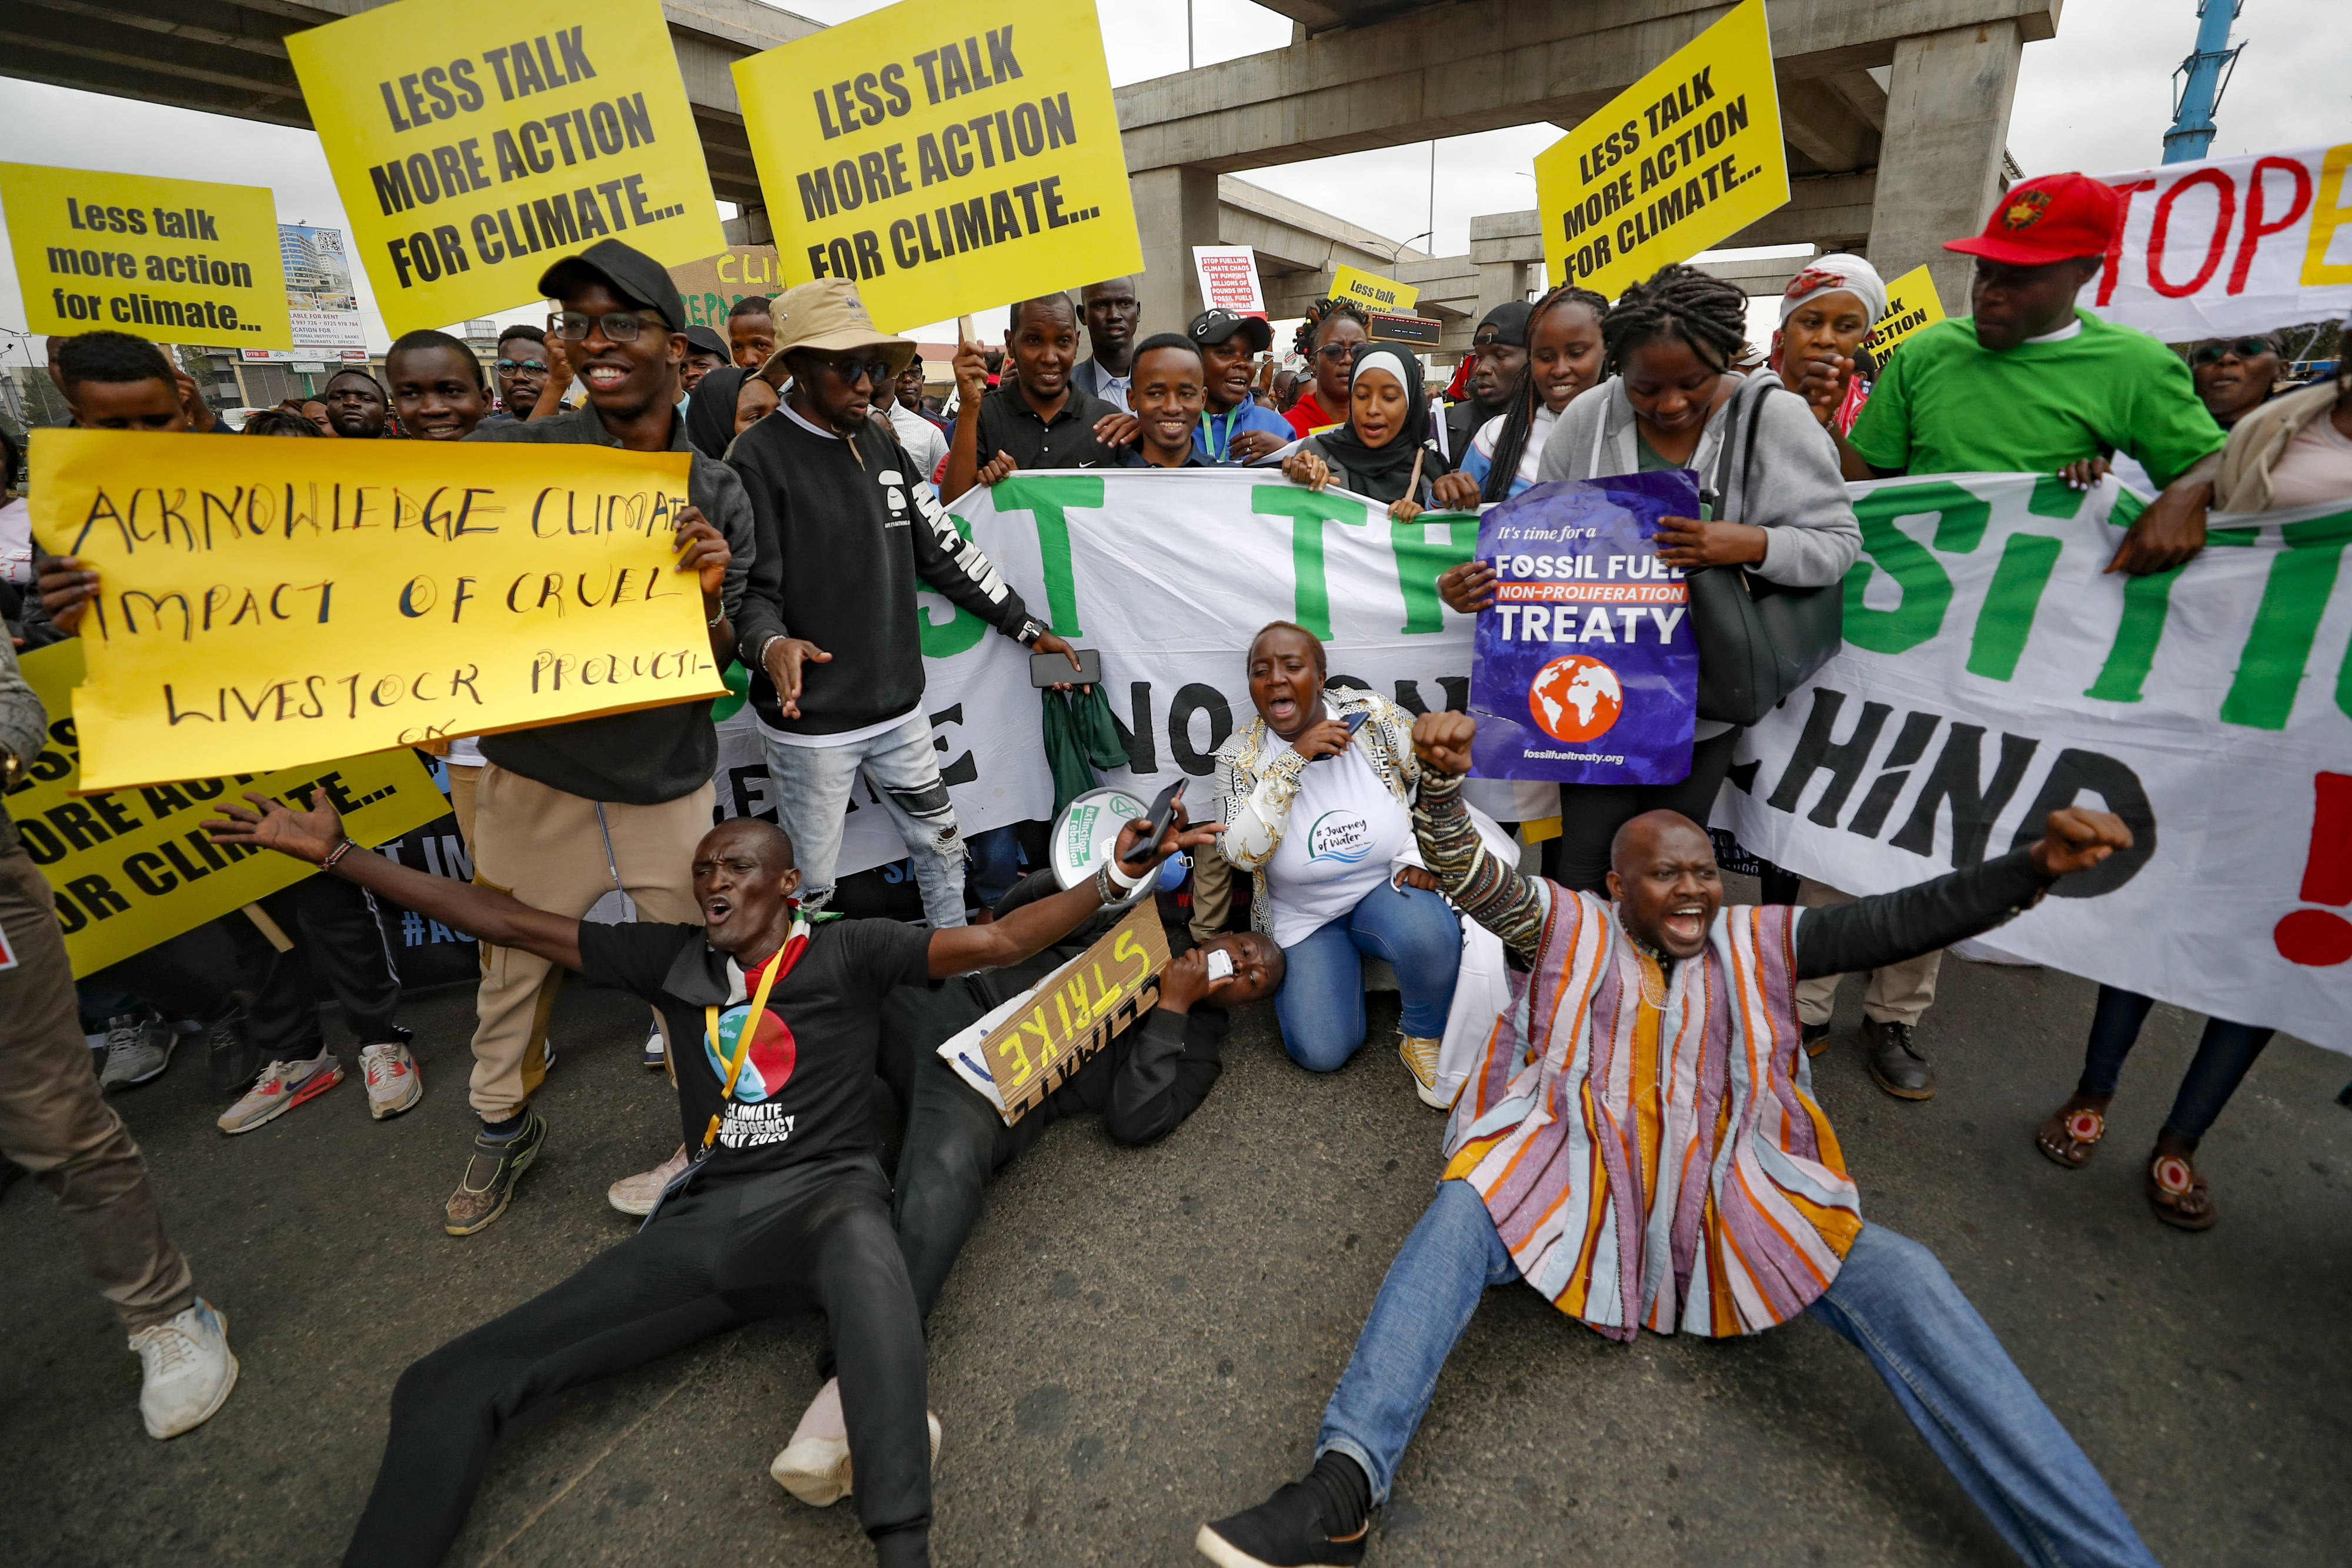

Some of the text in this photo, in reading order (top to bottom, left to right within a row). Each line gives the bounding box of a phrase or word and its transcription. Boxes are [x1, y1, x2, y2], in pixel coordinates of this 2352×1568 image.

[379, 25, 597, 133] LESS TALK
[813, 24, 1024, 141] LESS TALK
[1580, 65, 1716, 186] LESS TALK
[369, 92, 656, 216] MORE ACTION
[796, 91, 1077, 223] MORE ACTION
[1563, 94, 1750, 242] MORE ACTION
[67, 198, 218, 241] Less talk
[387, 173, 685, 289] FOR CLIMATE...
[807, 175, 1100, 282] FOR CLIMATE...
[1564, 154, 1762, 285] FOR CLIMATE...
[47, 248, 252, 288] more action
[1350, 279, 1396, 305] Less talk
[53, 288, 261, 332] for climate...
[532, 486, 689, 545] CLIMAT
[1498, 525, 1597, 542] It's time for a
[1495, 554, 1688, 580] FOSSIL FUEL
[1499, 585, 1684, 601] NON-PROLIFERATION
[91, 563, 683, 649] IMPACT OF CRUEL
[1495, 605, 1687, 644] TREATY
[1524, 748, 1625, 765] fossilfueltreaty.org
[15, 792, 144, 865] ORE
[1069, 820, 1080, 867] rebellion
[1080, 807, 1095, 854] extinction
[1318, 838, 1328, 852] of
[1329, 833, 1361, 848] Water
[1324, 819, 1367, 837] Journey
[54, 874, 132, 935] OR
[998, 928, 1151, 1087] STRIKE
[725, 1102, 782, 1121] CLIMATE
